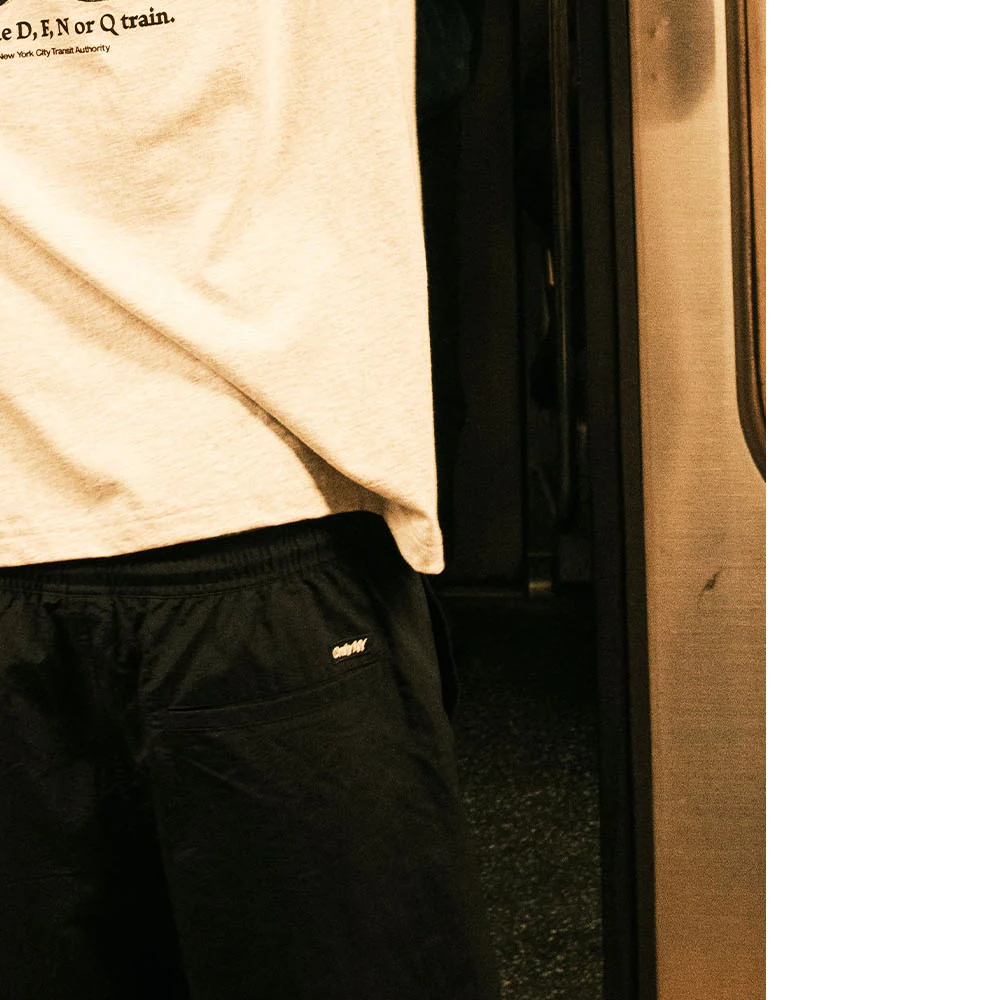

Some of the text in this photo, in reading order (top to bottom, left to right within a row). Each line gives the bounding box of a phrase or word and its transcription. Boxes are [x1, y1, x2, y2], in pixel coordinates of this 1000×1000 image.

[16, 21, 37, 40] D,
[74, 20, 95, 35] or
[99, 13, 119, 36] Q
[120, 6, 175, 30] train.
[16, 50, 34, 58] York
[35, 48, 51, 57] City
[51, 46, 75, 55] Transit
[75, 44, 111, 54] Authority
